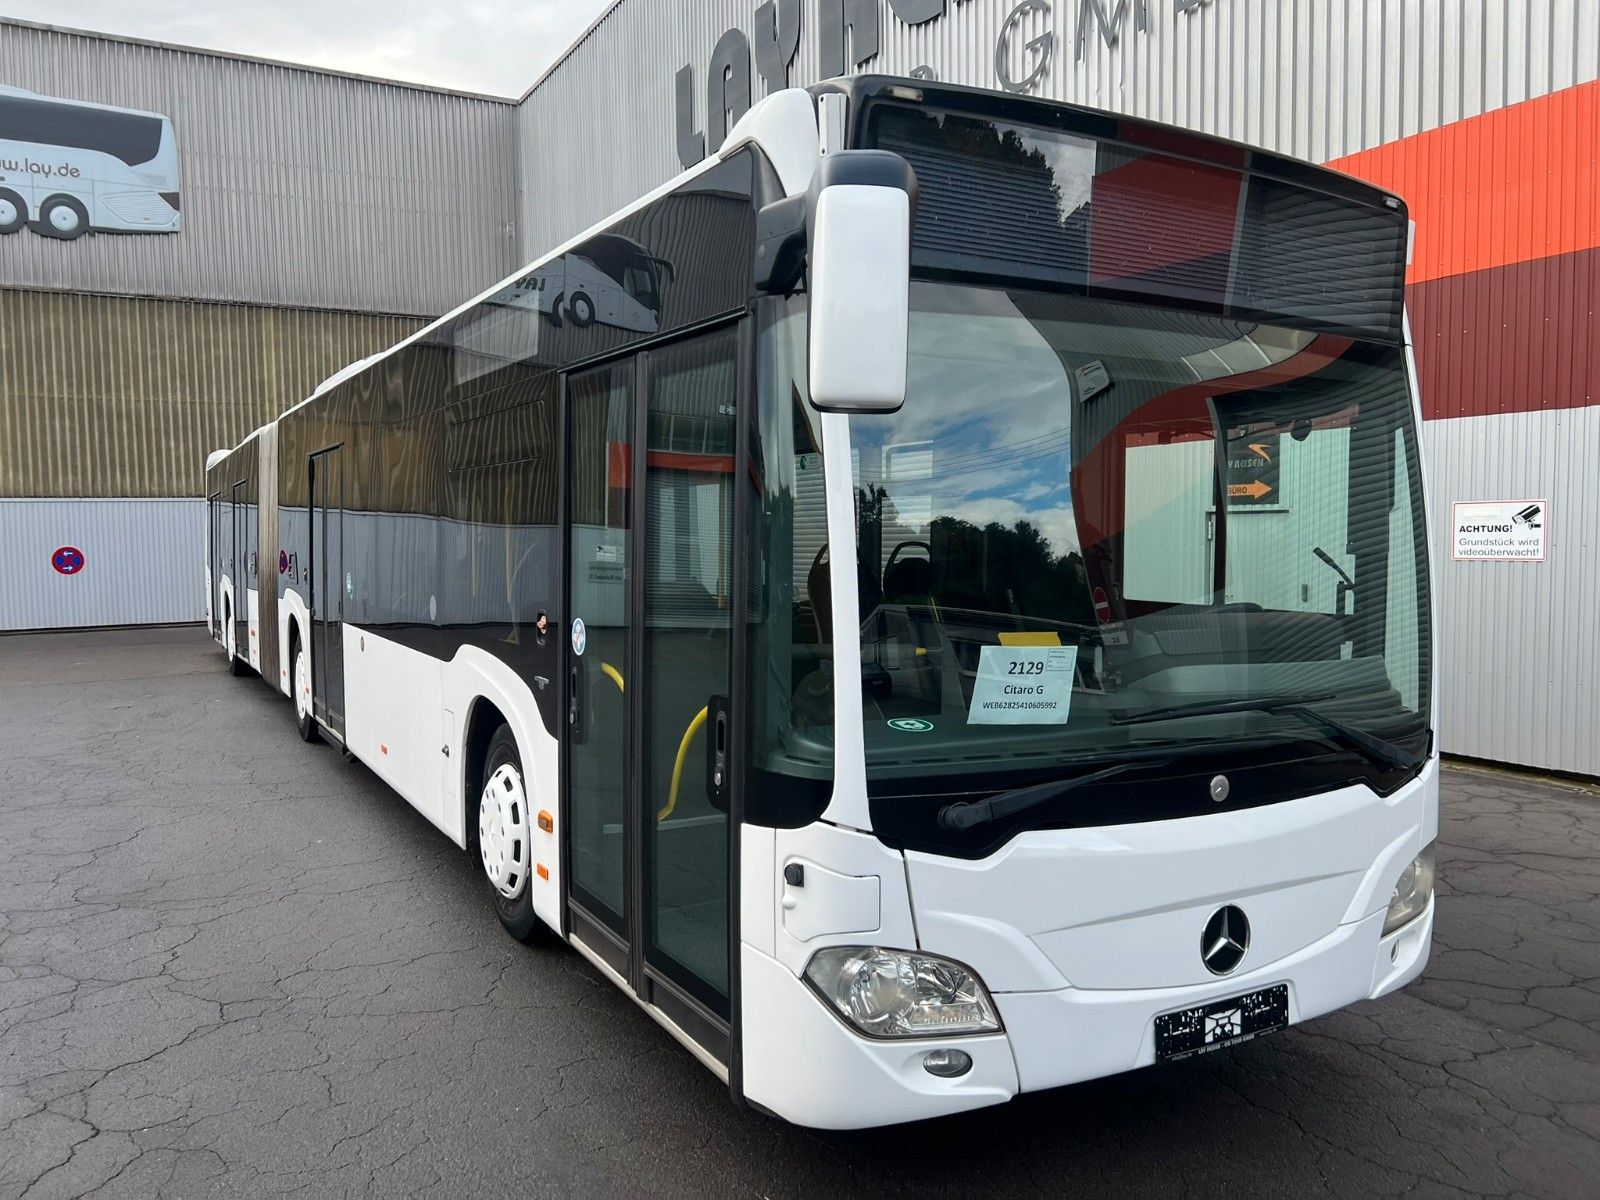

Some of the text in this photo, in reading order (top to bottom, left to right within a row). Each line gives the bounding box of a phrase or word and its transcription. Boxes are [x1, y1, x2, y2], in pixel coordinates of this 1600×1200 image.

[0, 158, 80, 178] w.lay.de
[1459, 524, 1513, 533] ACHTUNG!
[1459, 537, 1540, 546] Grundstück wird
[1458, 548, 1540, 556] videoüberwacht!
[1008, 661, 1044, 675] 2129
[1004, 684, 1044, 695] Citaro G
